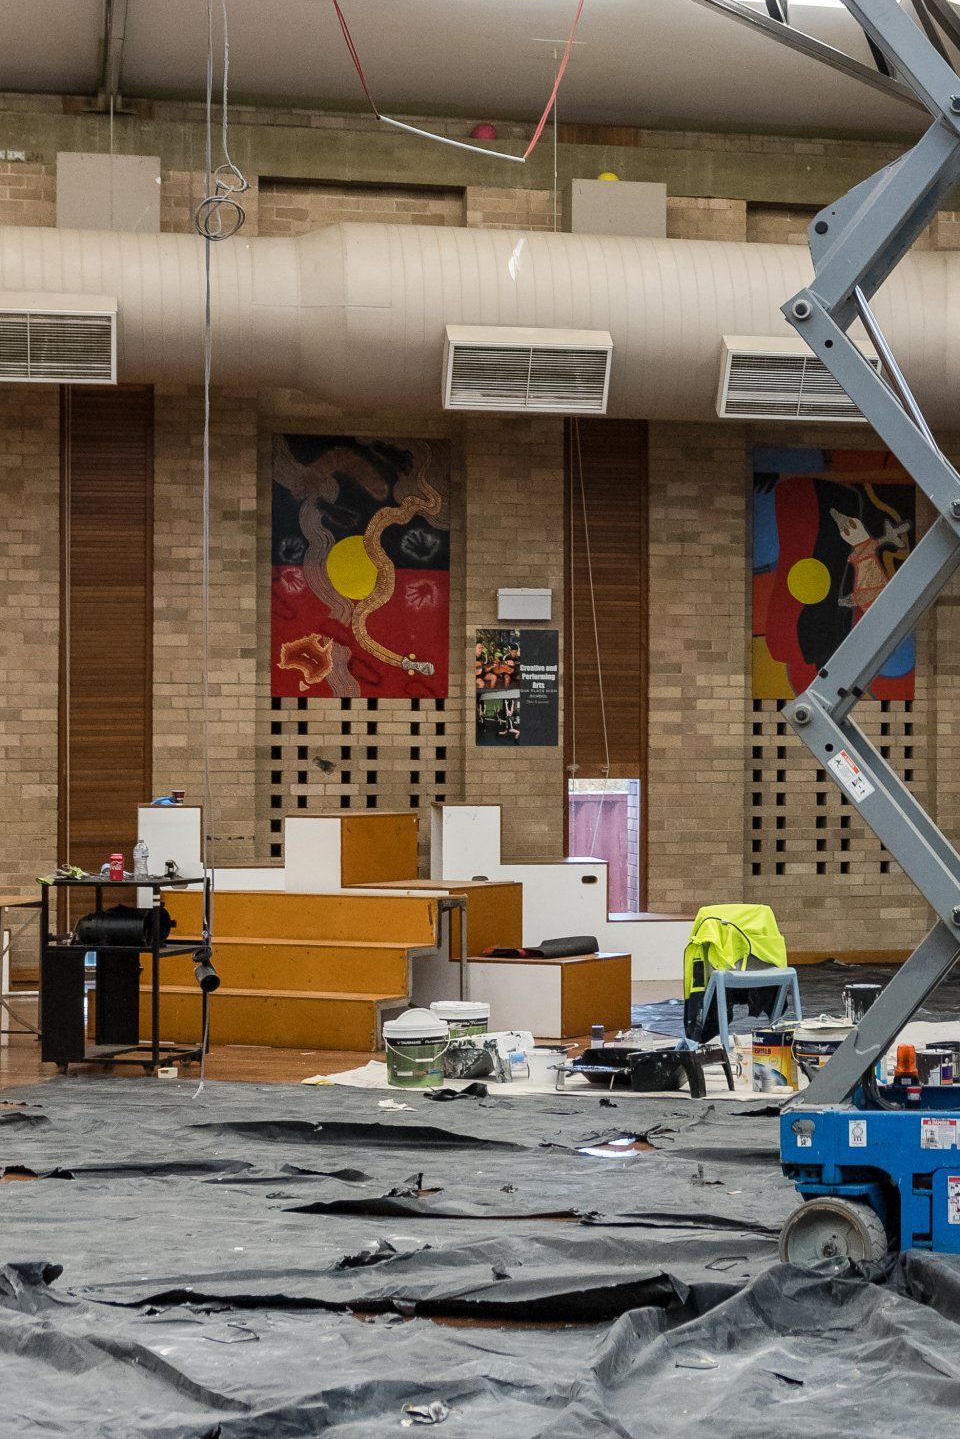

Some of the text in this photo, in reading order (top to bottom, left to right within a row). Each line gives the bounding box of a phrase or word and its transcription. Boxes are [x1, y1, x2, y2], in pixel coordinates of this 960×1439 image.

[520, 664, 558, 672] Creative and
[521, 673, 556, 681] Performing
